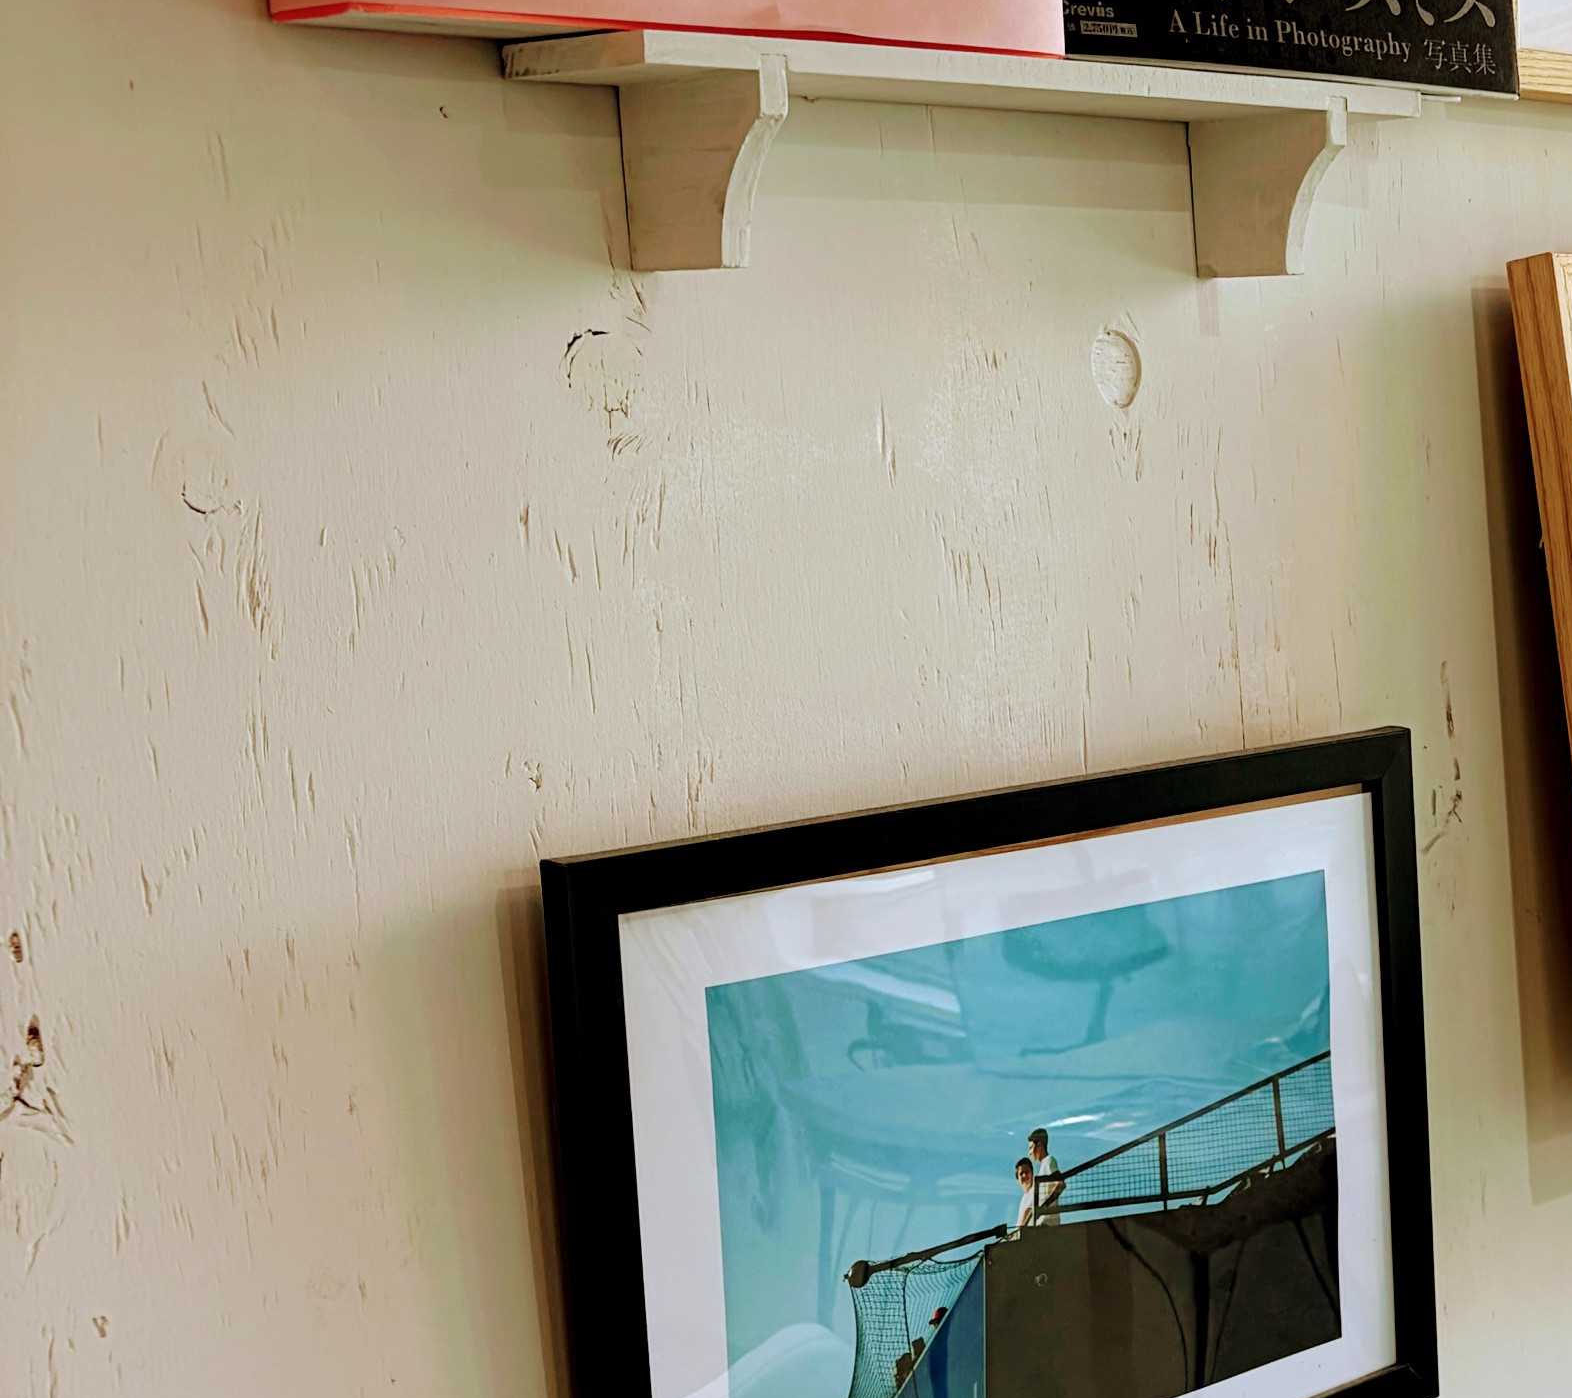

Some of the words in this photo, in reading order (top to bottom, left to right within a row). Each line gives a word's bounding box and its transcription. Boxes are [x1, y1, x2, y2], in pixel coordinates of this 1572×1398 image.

[1169, 9, 1186, 34] A
[1192, 11, 1240, 39] Life
[1247, 18, 1268, 42] in
[1274, 19, 1412, 62] Photography
[1423, 38, 1497, 75] 写真集
